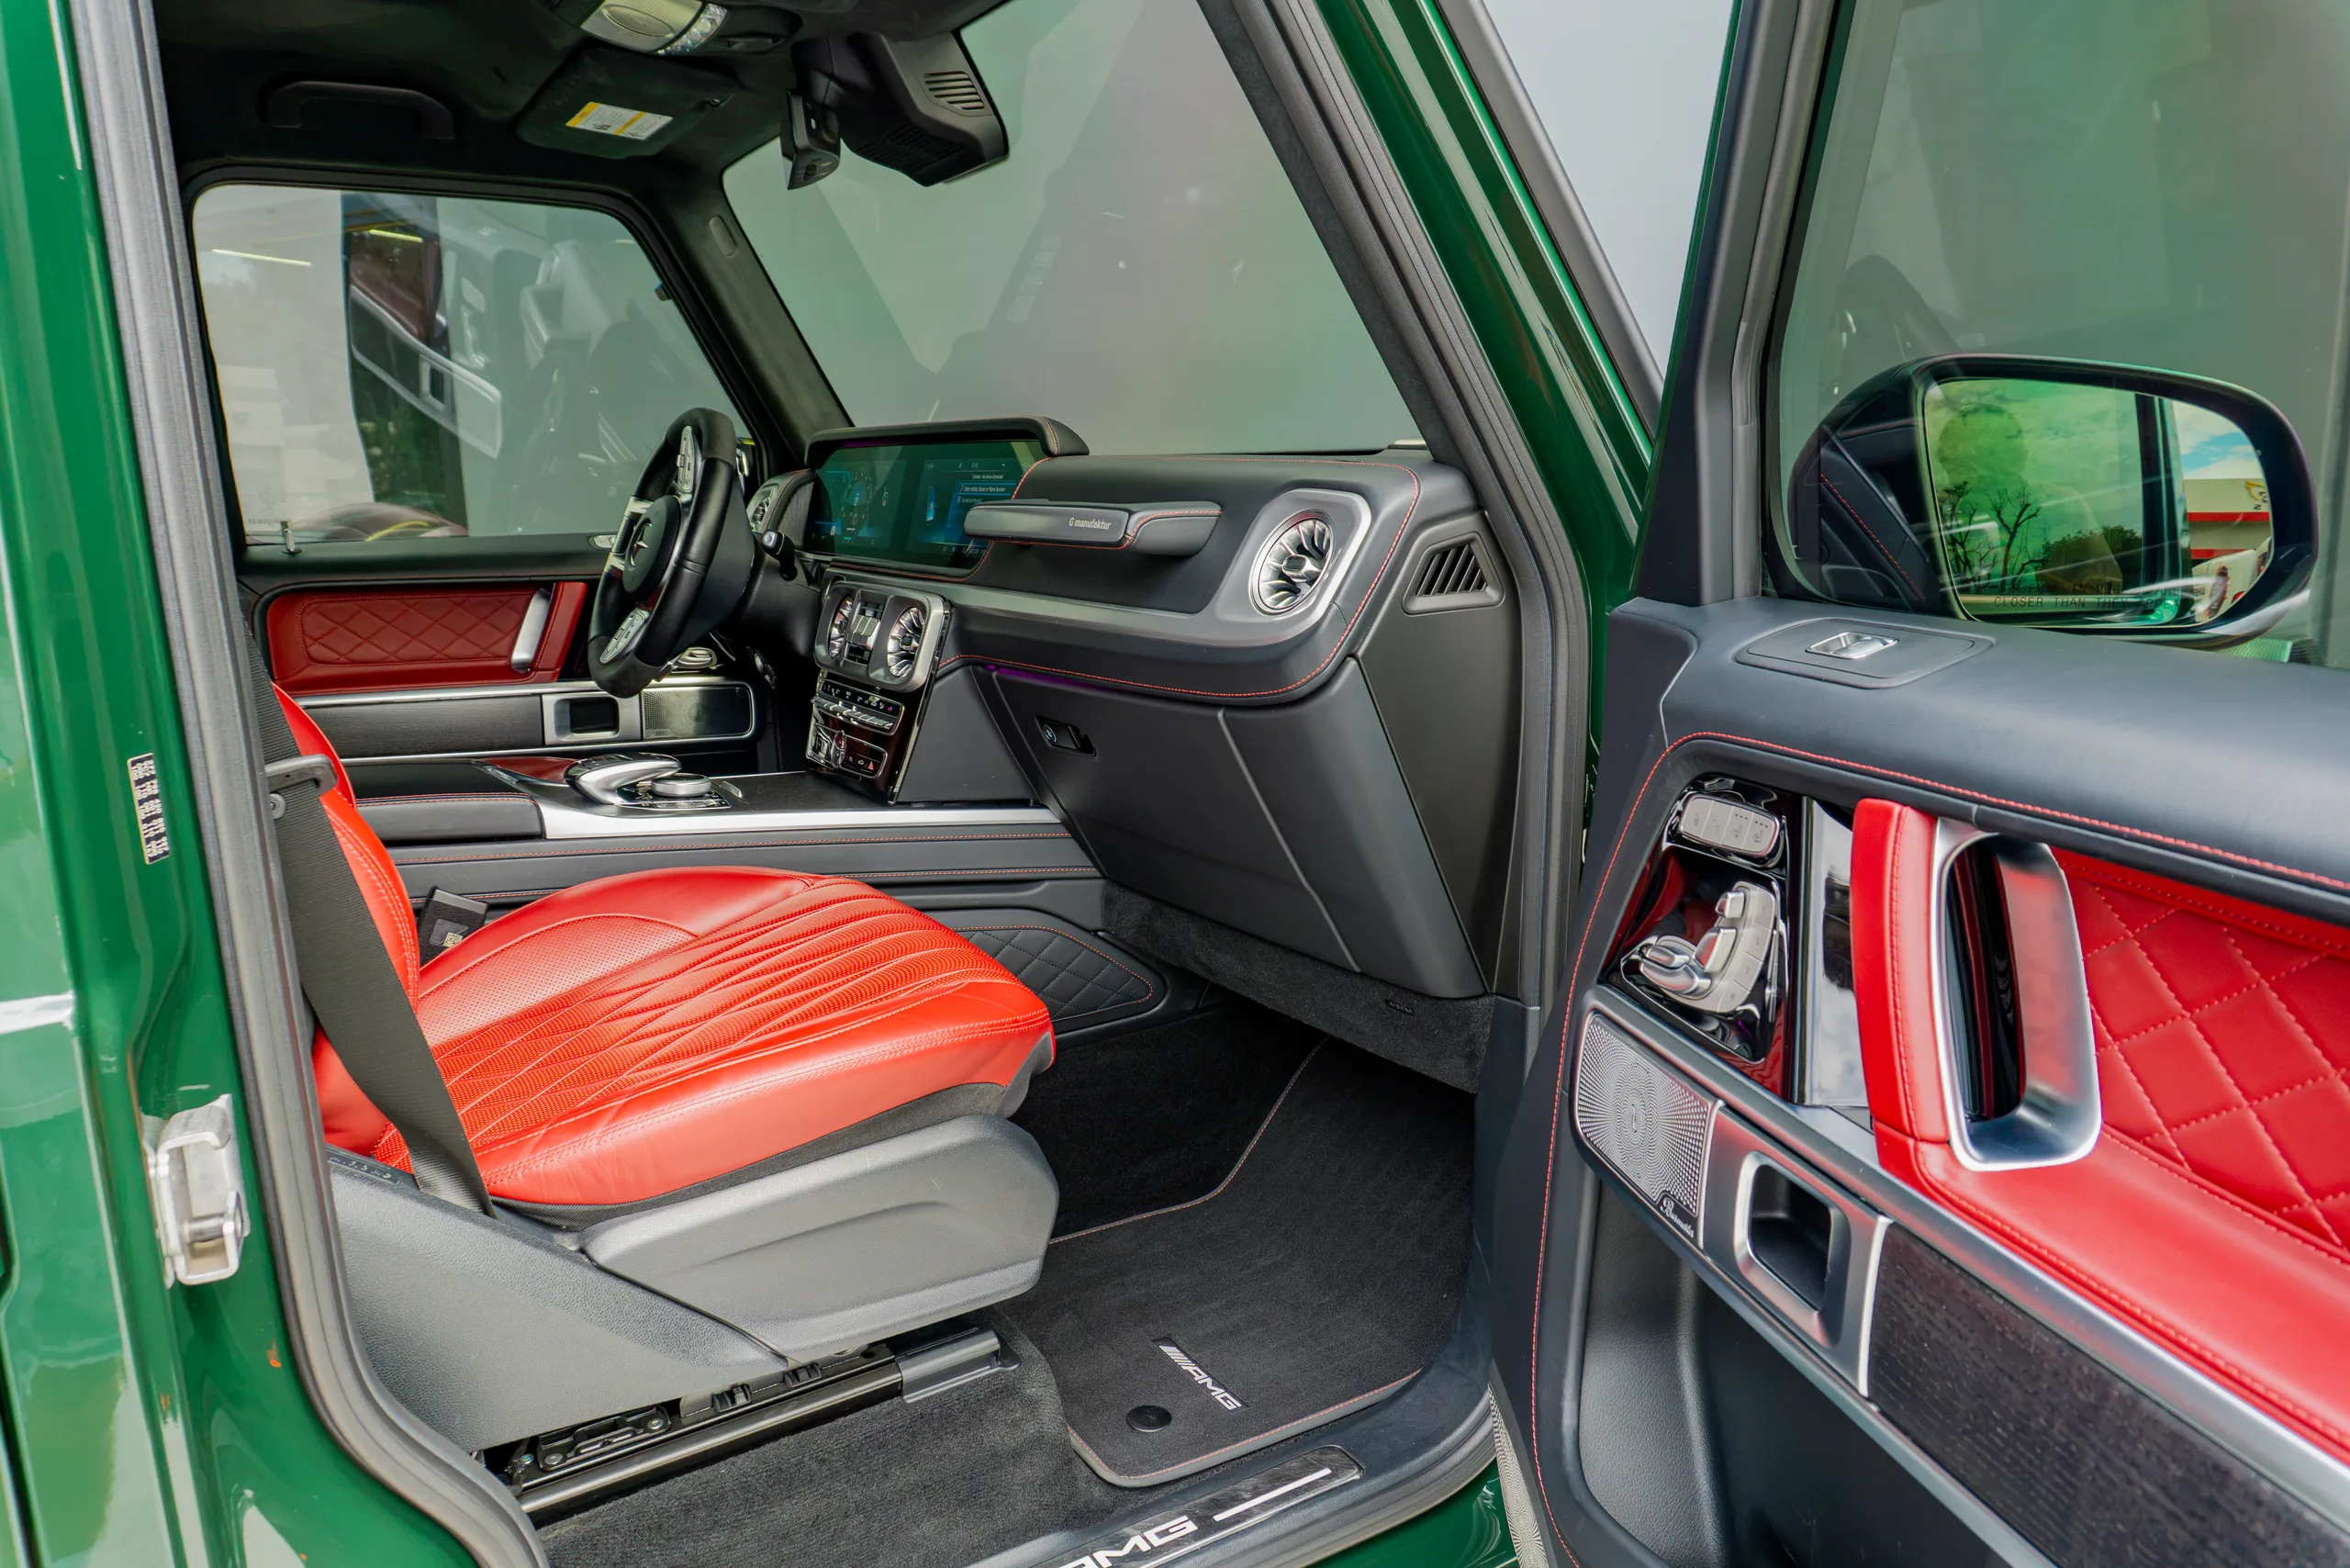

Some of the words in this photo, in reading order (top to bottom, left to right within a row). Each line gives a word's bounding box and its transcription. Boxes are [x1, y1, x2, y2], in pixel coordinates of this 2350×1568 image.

[1069, 517, 1075, 527] G
[1074, 519, 1112, 530] manufaktur
[1994, 596, 2043, 608] CLOSER
[2053, 597, 2087, 609] THAN
[1180, 1365, 1242, 1411] AMG
